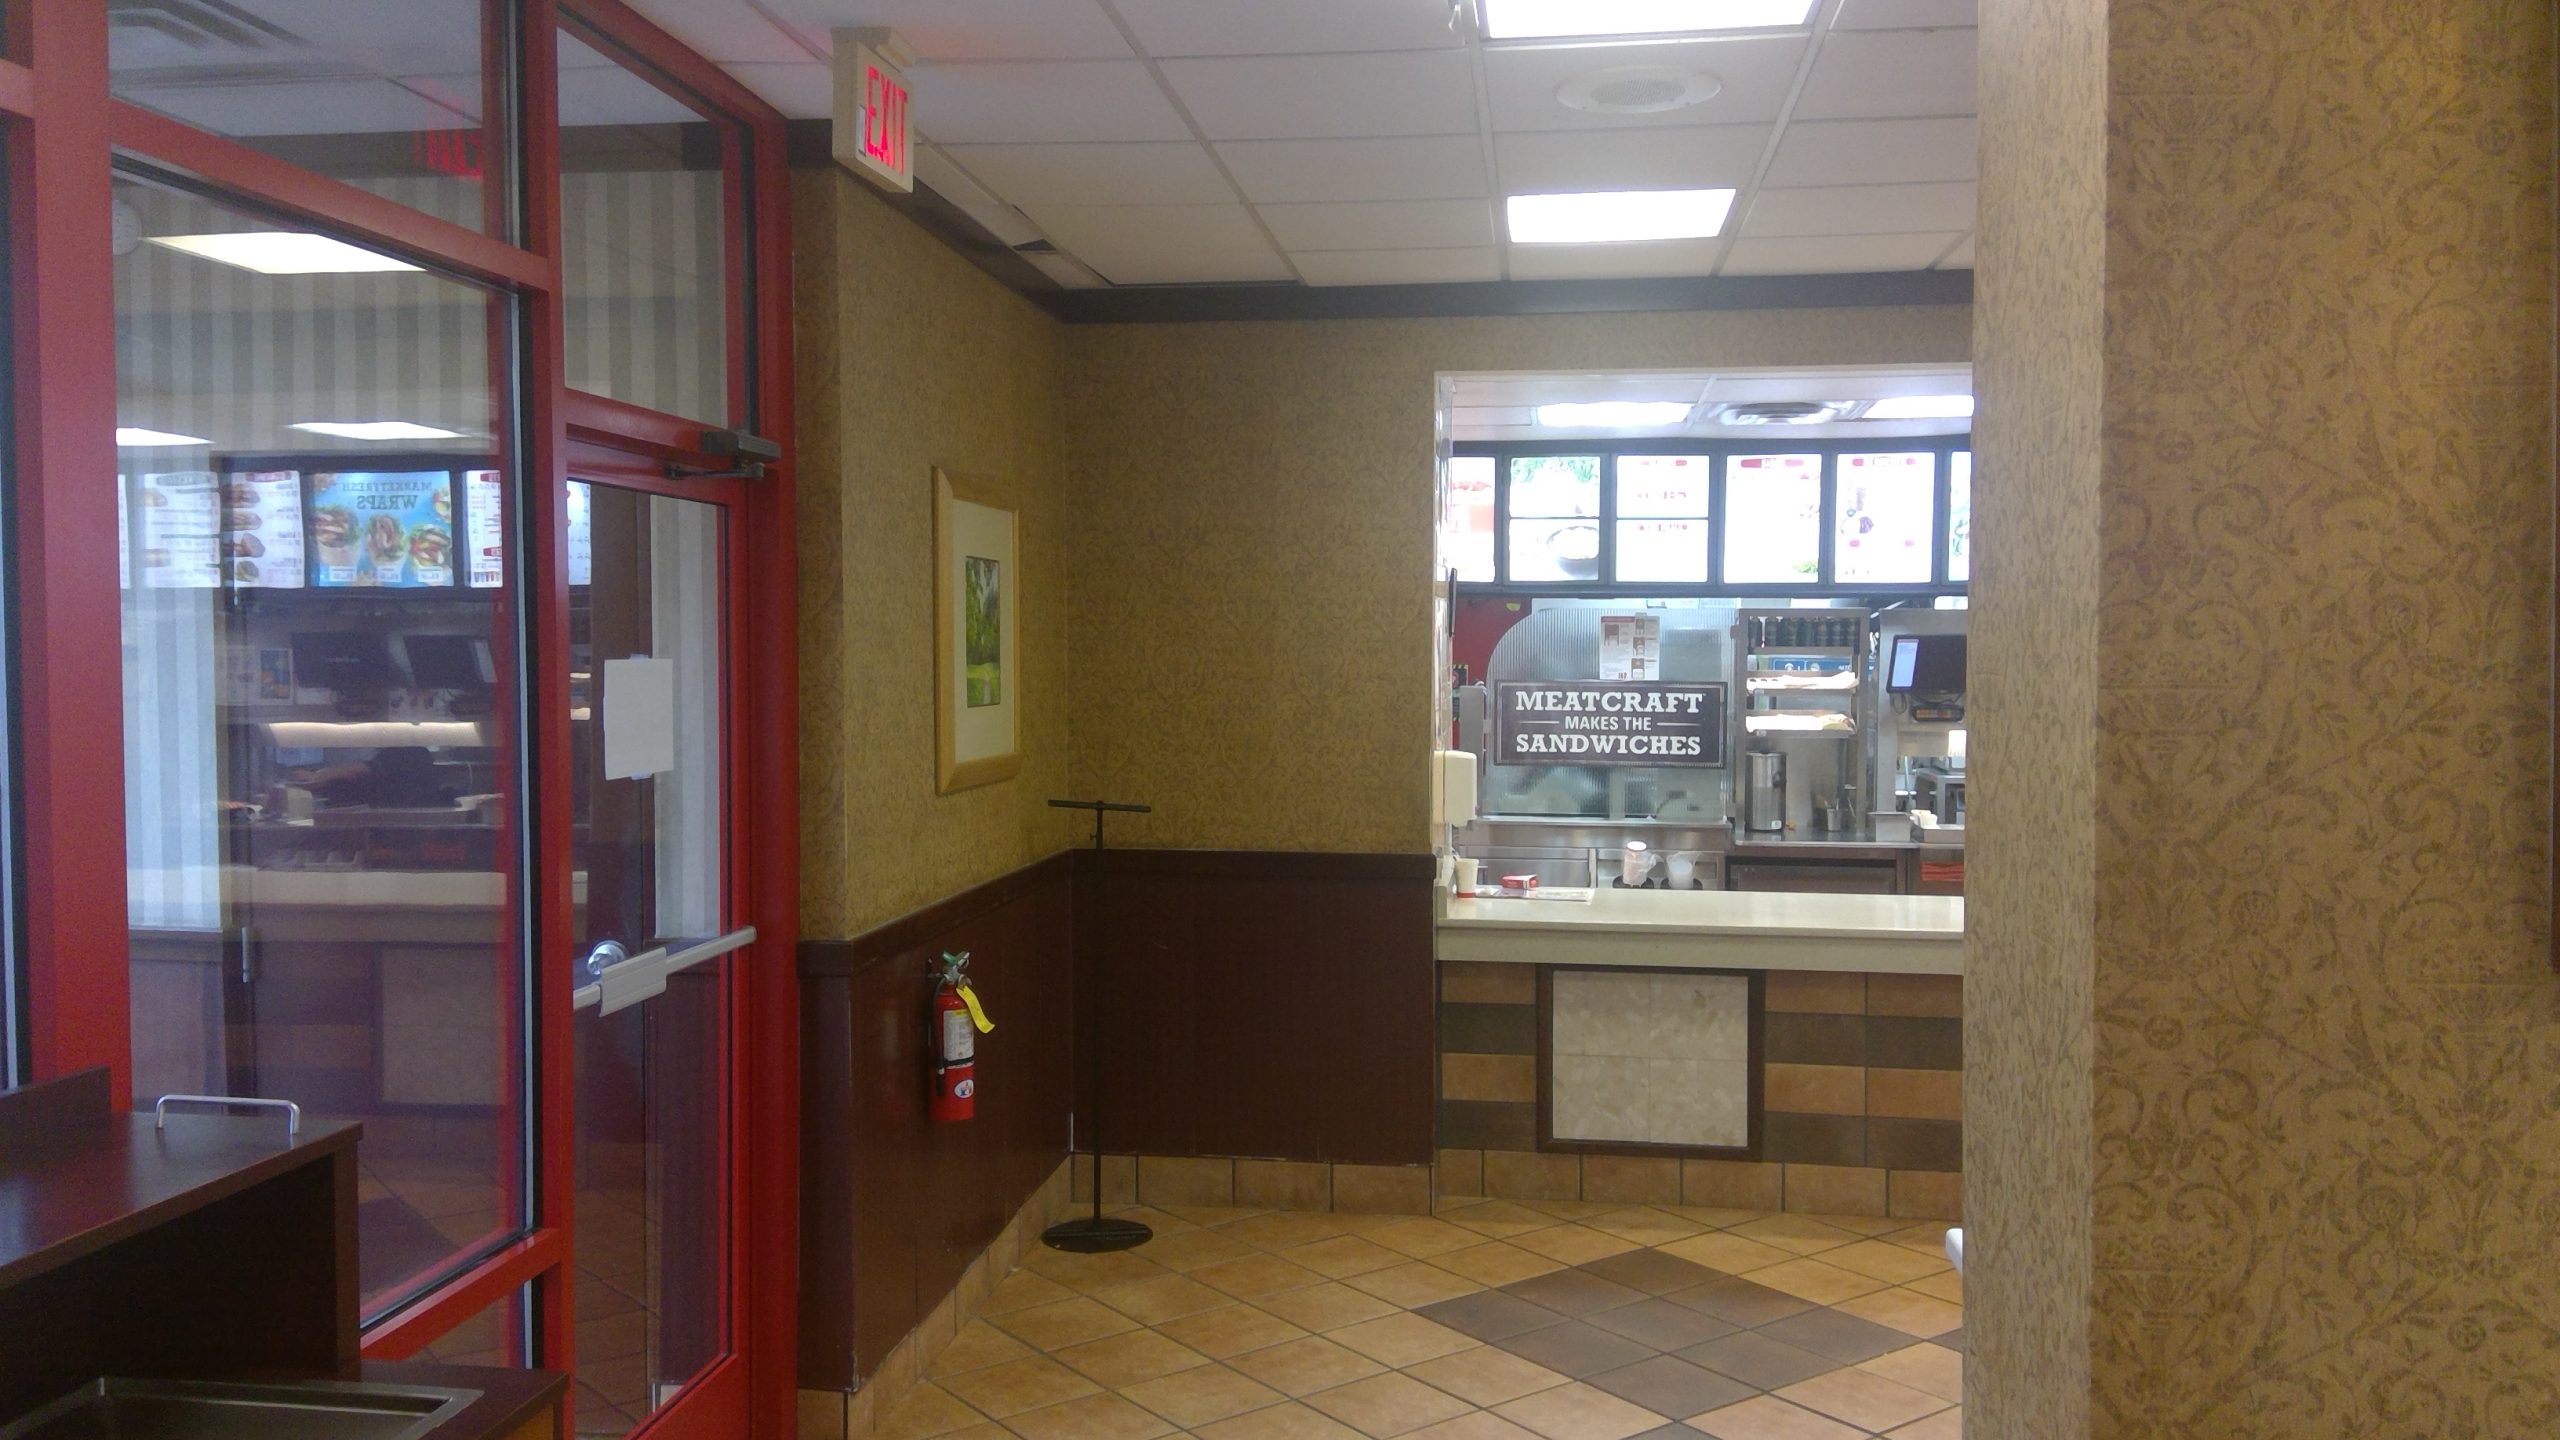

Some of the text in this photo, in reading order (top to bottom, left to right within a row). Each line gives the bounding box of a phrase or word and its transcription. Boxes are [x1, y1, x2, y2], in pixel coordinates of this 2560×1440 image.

[865, 63, 908, 176] EXIT
[1515, 690, 1703, 713] MEATCRAFT
[1564, 715, 1652, 731] MAKES THE
[1516, 733, 1701, 755] SANDWICHES
